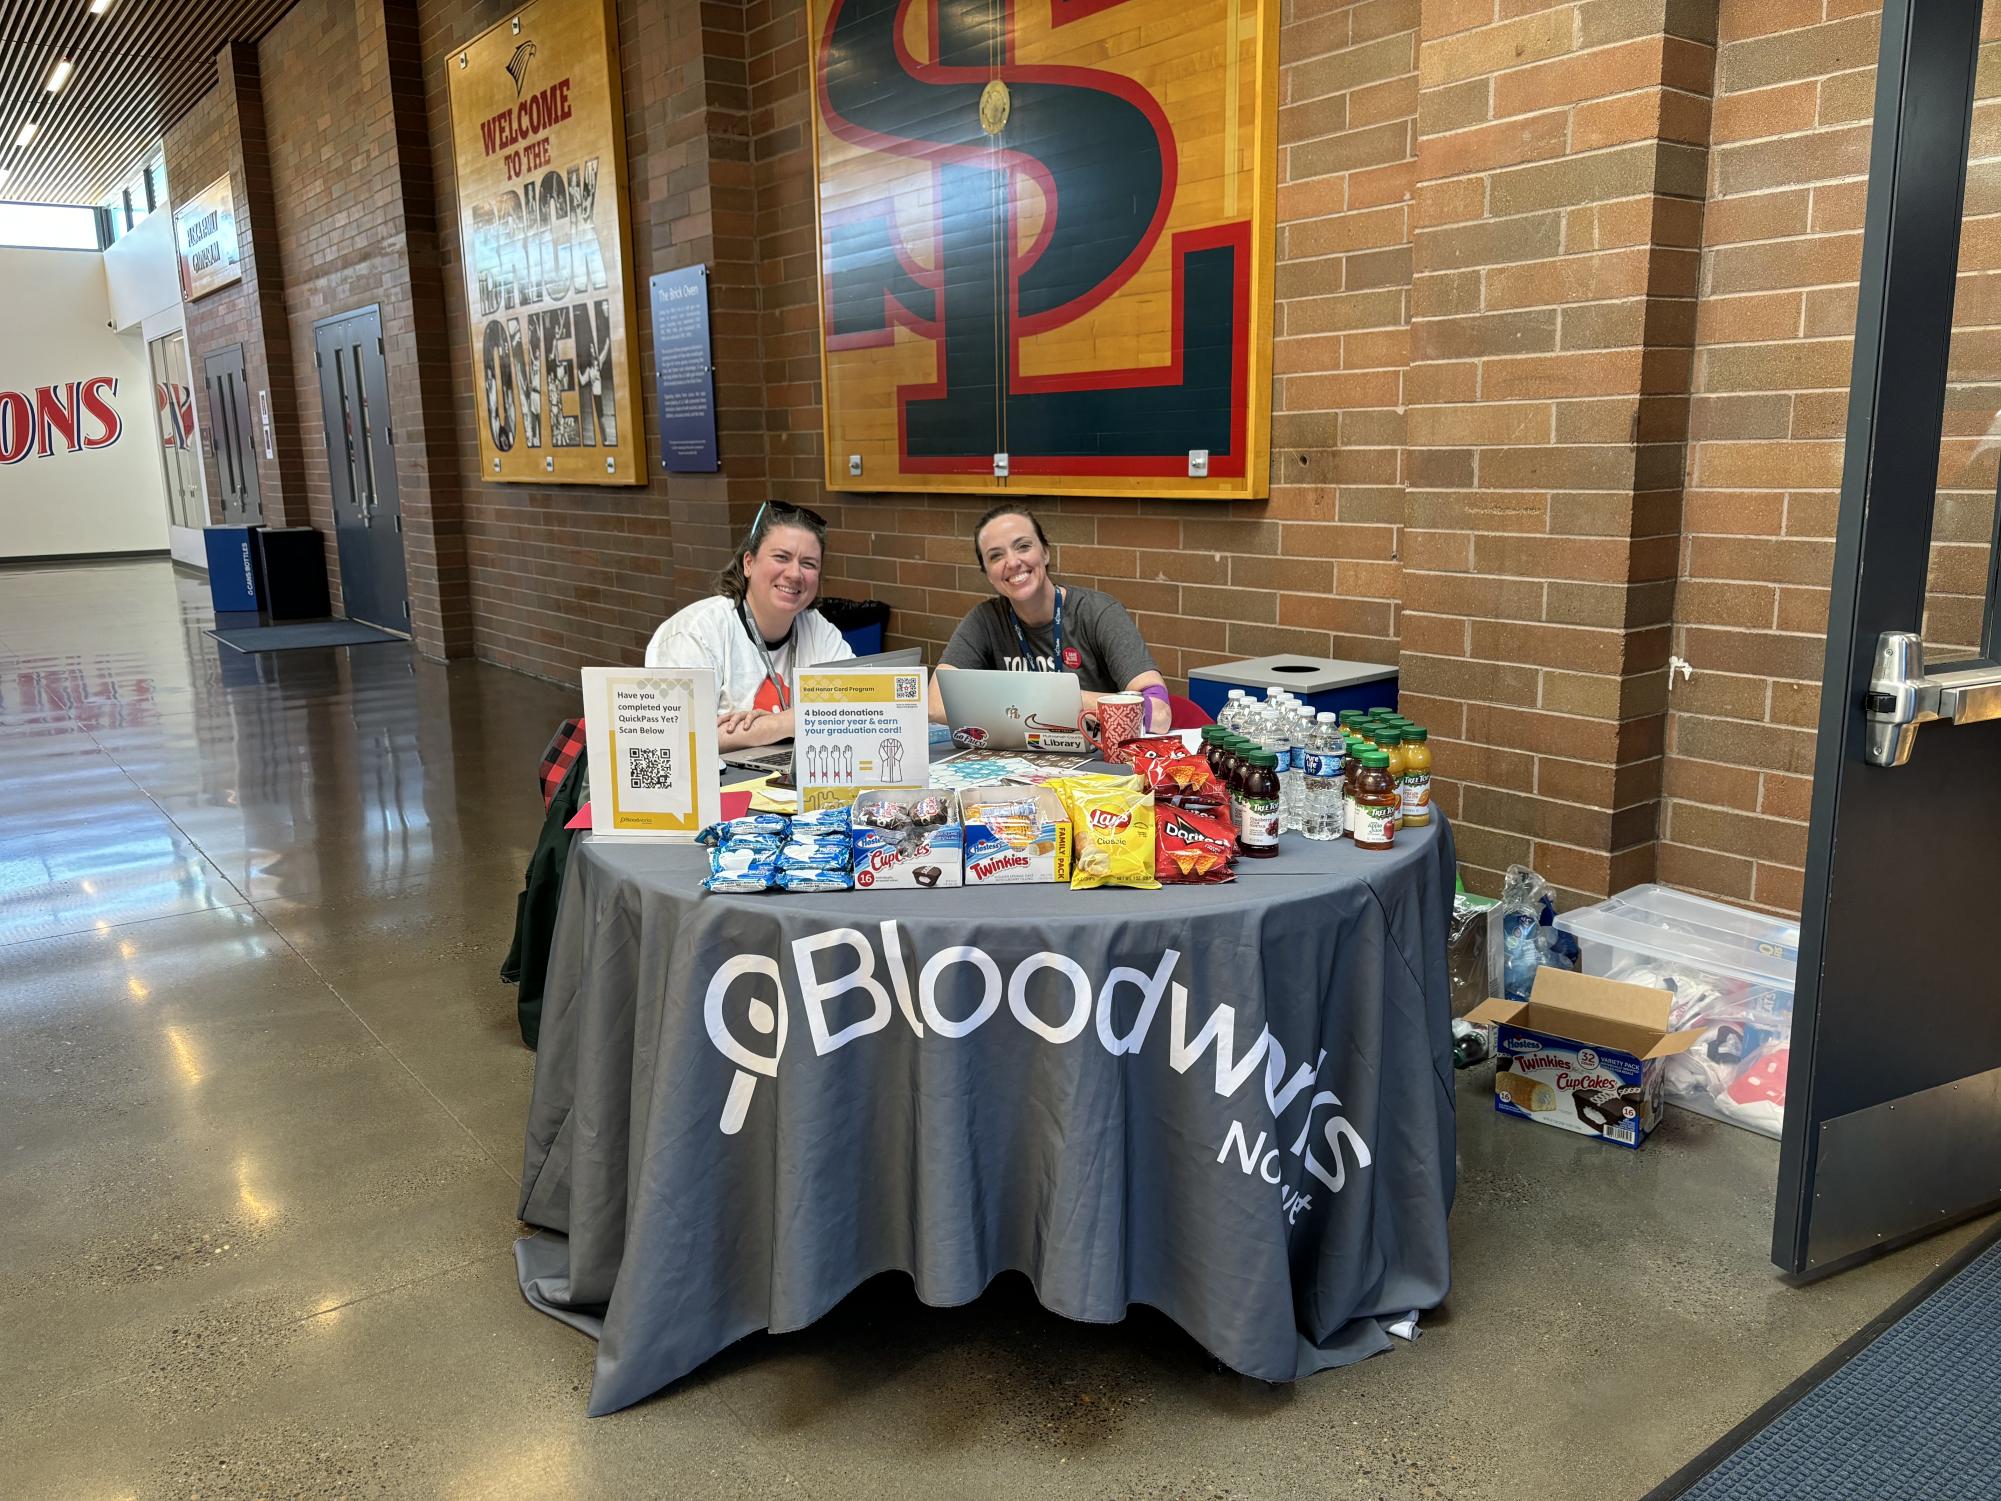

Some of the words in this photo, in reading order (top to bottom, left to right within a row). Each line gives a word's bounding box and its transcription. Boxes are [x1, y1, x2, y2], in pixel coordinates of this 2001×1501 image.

[481, 77, 572, 157] WELCOME
[504, 151, 523, 182] TO
[524, 136, 552, 175] THE
[471, 156, 609, 318] BRICK
[658, 289, 669, 302] The
[669, 287, 682, 300] Brick
[682, 284, 699, 298] Oven
[483, 299, 619, 453] OVEN
[241, 542, 250, 572] BOTTLES
[617, 691, 638, 699] Have
[639, 693, 655, 701] you
[618, 703, 661, 712] completed
[804, 709, 810, 717] 4
[812, 709, 837, 717] blood
[839, 709, 884, 717] donations
[618, 715, 659, 723] QuickPass
[661, 715, 679, 723] Yet?
[804, 718, 816, 726] by
[848, 719, 867, 727] year
[640, 727, 665, 735] Below
[804, 728, 826, 736] your
[827, 726, 877, 736] graduation
[879, 726, 902, 734] cord!
[1044, 738, 1081, 748] Library
[1305, 753, 1319, 762] Pure
[1306, 761, 1317, 769] Life
[1166, 823, 1223, 846] Doritos
[974, 841, 1000, 852] Hostess
[1058, 827, 1066, 855] FAMILY
[871, 844, 930, 872] Cupes
[969, 854, 1029, 881] Twinkies
[1057, 858, 1065, 879] PACK
[860, 874, 873, 883] 16
[1508, 1039, 1540, 1050] Hostess
[791, 919, 1372, 1193] Bloodwrs
[1581, 1051, 1595, 1063] 32
[1514, 1054, 1571, 1072] Twinkies
[1600, 1057, 1623, 1067] VARIETY
[1624, 1062, 1640, 1070] PACK
[1556, 1073, 1616, 1090] CupCakes
[1501, 1093, 1510, 1101] 16
[1624, 1108, 1634, 1116] 16
